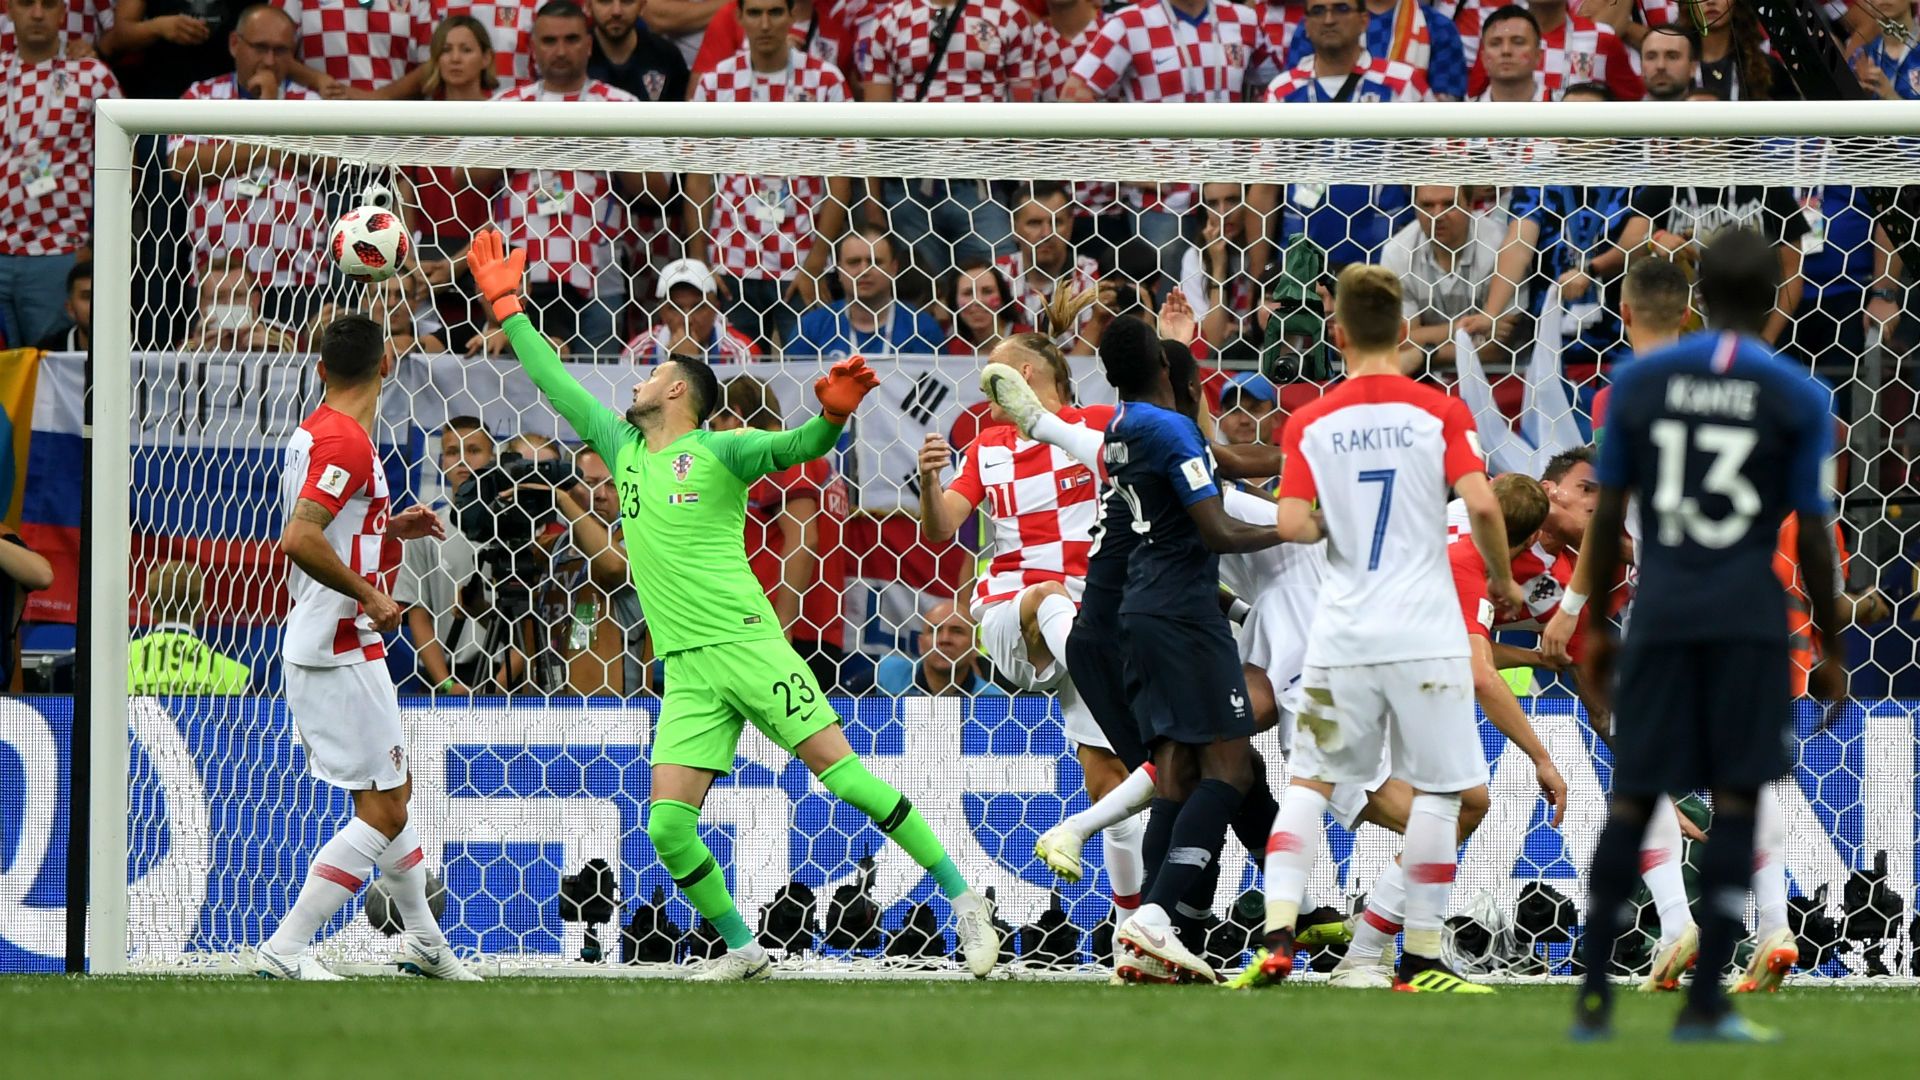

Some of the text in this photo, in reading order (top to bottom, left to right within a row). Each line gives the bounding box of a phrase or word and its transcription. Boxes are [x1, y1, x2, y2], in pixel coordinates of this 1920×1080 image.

[1663, 372, 1760, 421] KANTE
[1331, 423, 1414, 455] RAKITIĆ
[620, 481, 641, 519] 23
[1648, 419, 1763, 549] 13
[1357, 468, 1397, 572] 7
[772, 672, 816, 718] 23
